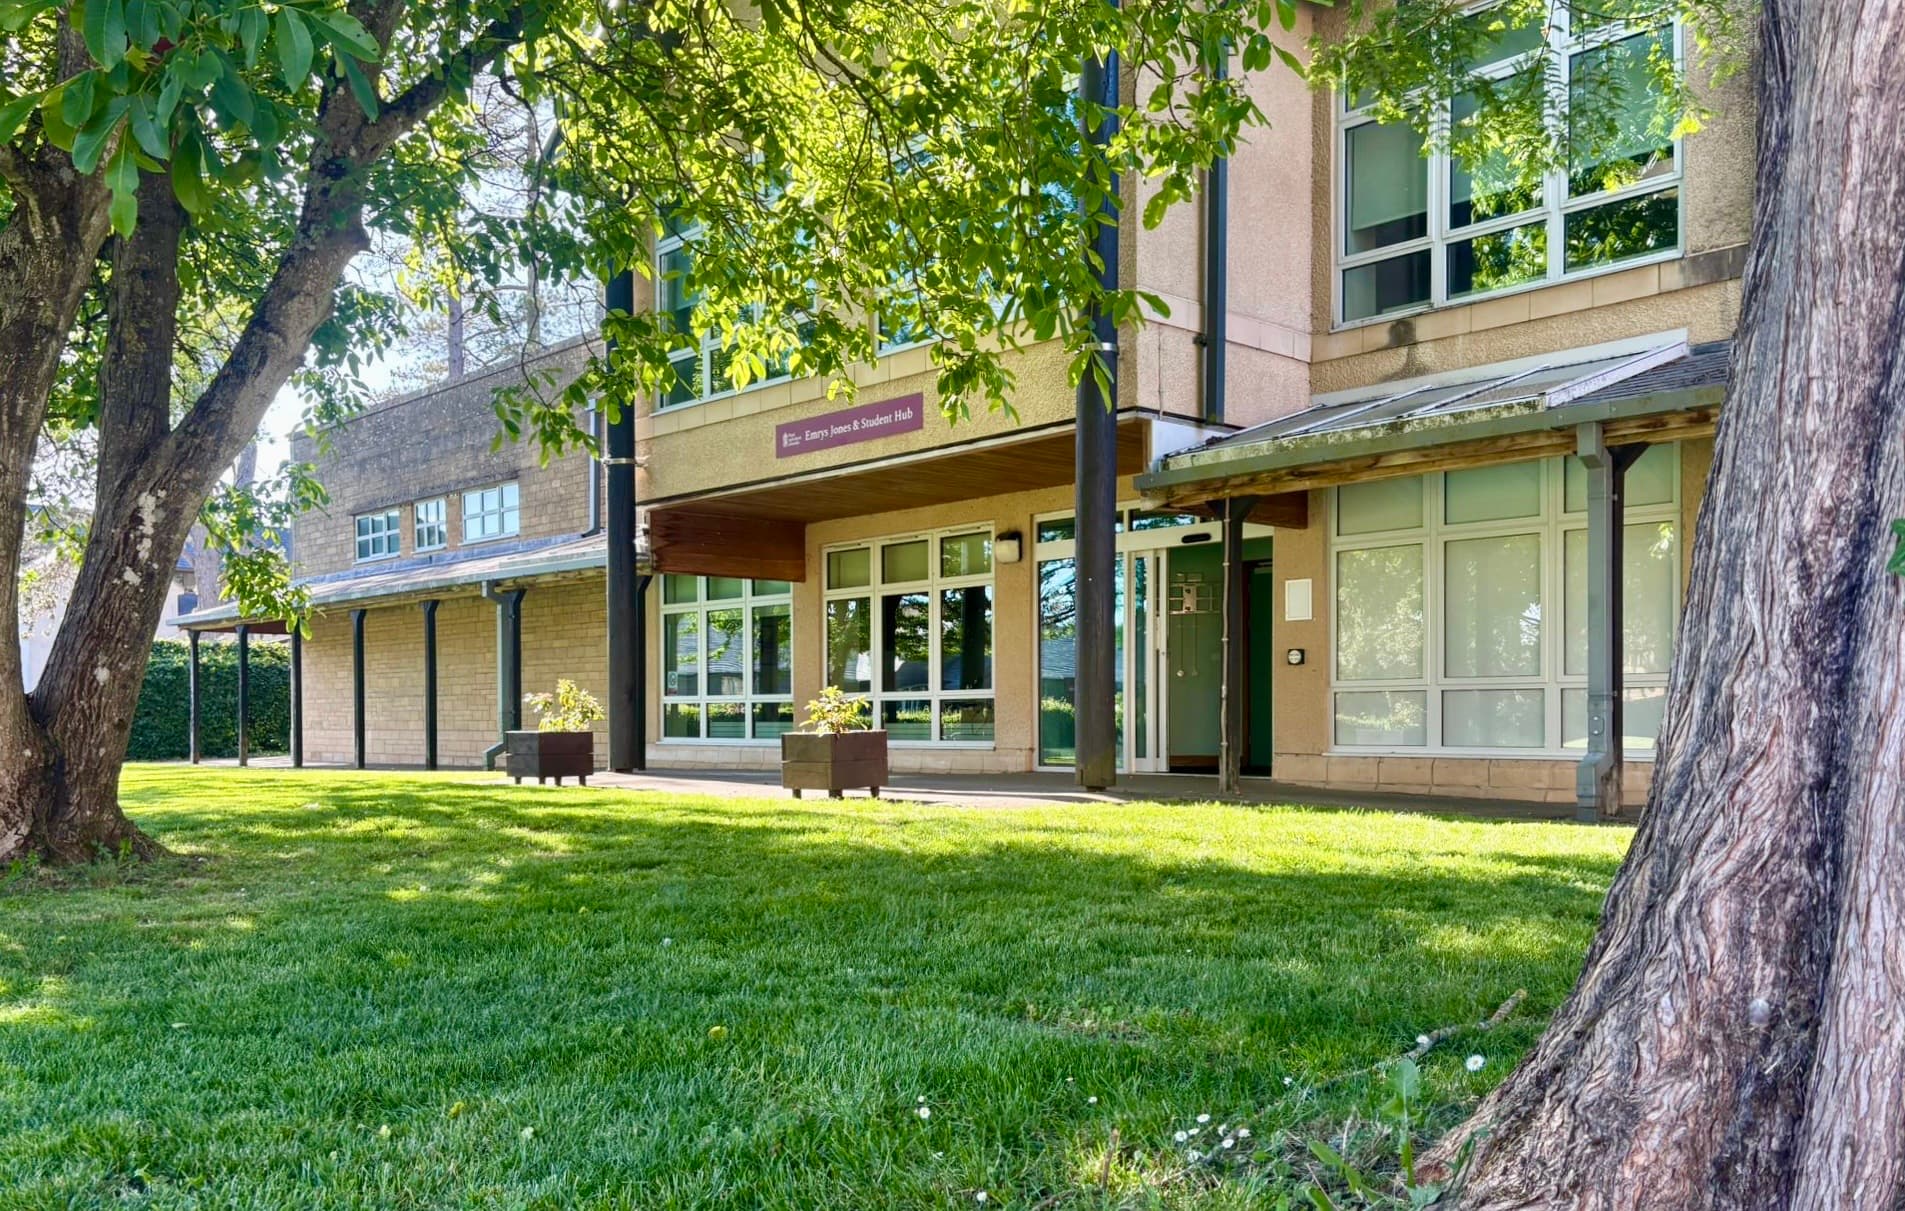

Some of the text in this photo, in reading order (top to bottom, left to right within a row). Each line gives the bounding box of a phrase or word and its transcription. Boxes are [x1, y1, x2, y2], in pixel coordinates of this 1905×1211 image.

[804, 407, 913, 441] Emrys Jones & Student Hub
